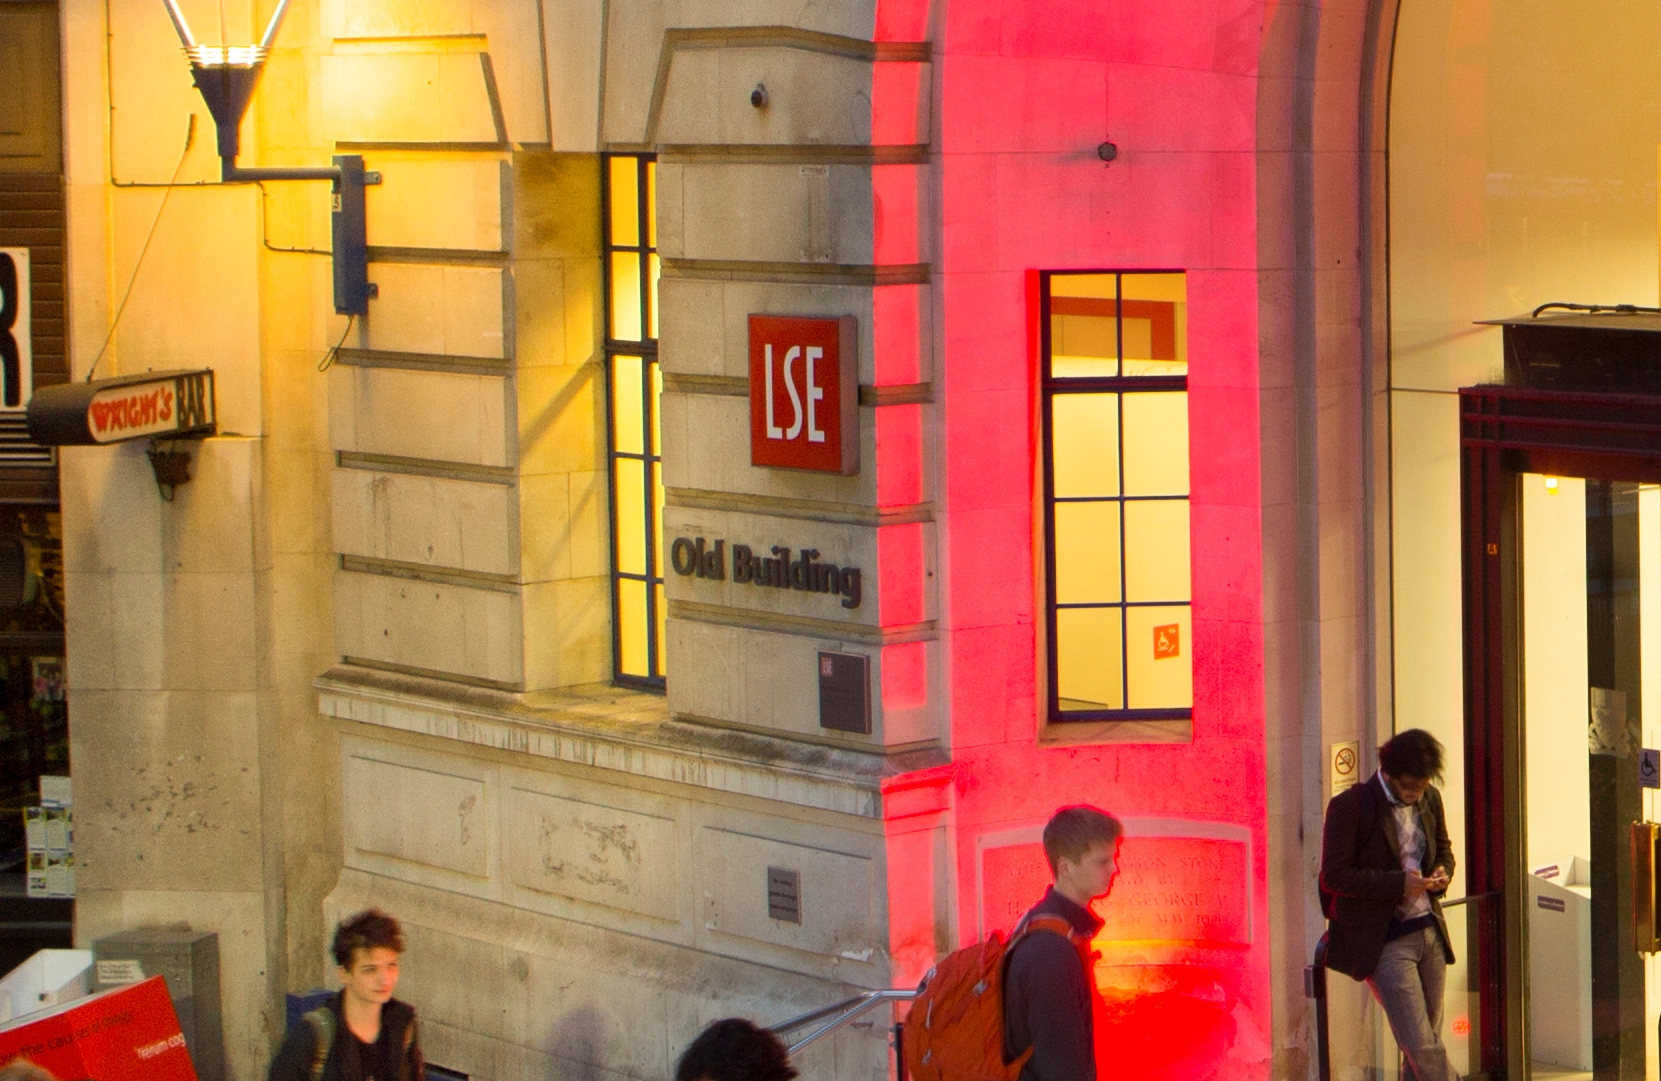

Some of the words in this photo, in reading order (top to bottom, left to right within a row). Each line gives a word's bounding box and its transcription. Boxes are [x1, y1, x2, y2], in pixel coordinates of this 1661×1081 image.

[764, 343, 825, 443] LSE
[671, 537, 725, 581] Old
[733, 544, 862, 609] Building
